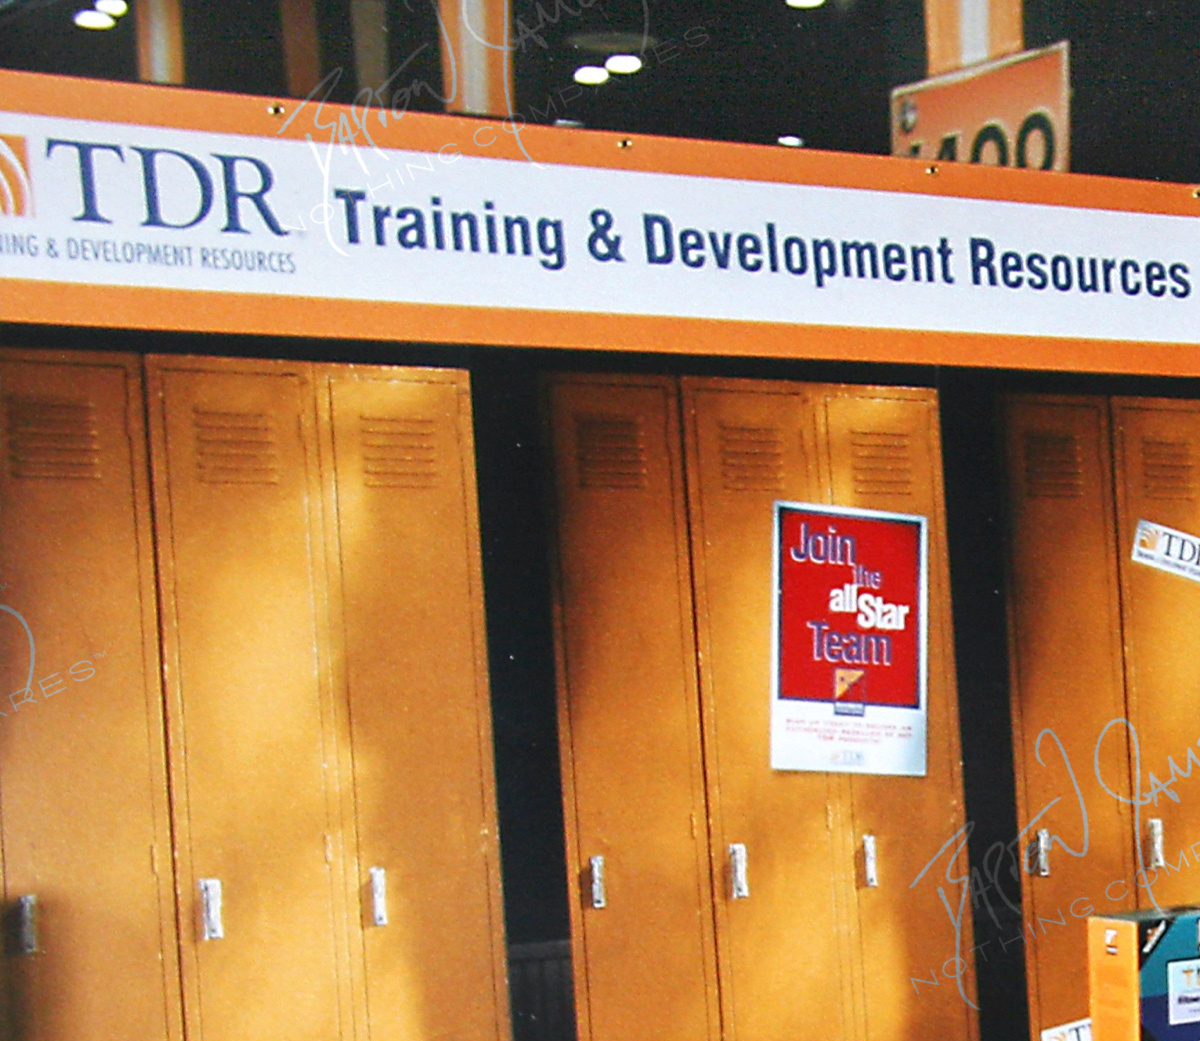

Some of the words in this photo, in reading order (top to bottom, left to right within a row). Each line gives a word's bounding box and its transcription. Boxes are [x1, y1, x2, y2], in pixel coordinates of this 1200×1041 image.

[46, 138, 291, 237] TDR
[47, 238, 60, 259] &
[67, 236, 194, 268] DEVELOPMENT
[200, 247, 297, 274] RESOURCES
[334, 188, 567, 271] Training
[587, 208, 627, 263] &
[641, 213, 955, 288] Development
[969, 237, 1191, 298] Resources
[790, 522, 857, 566] Join
[852, 564, 883, 589] the
[829, 584, 858, 613] all
[857, 593, 910, 631] Star
[806, 620, 893, 667] Team
